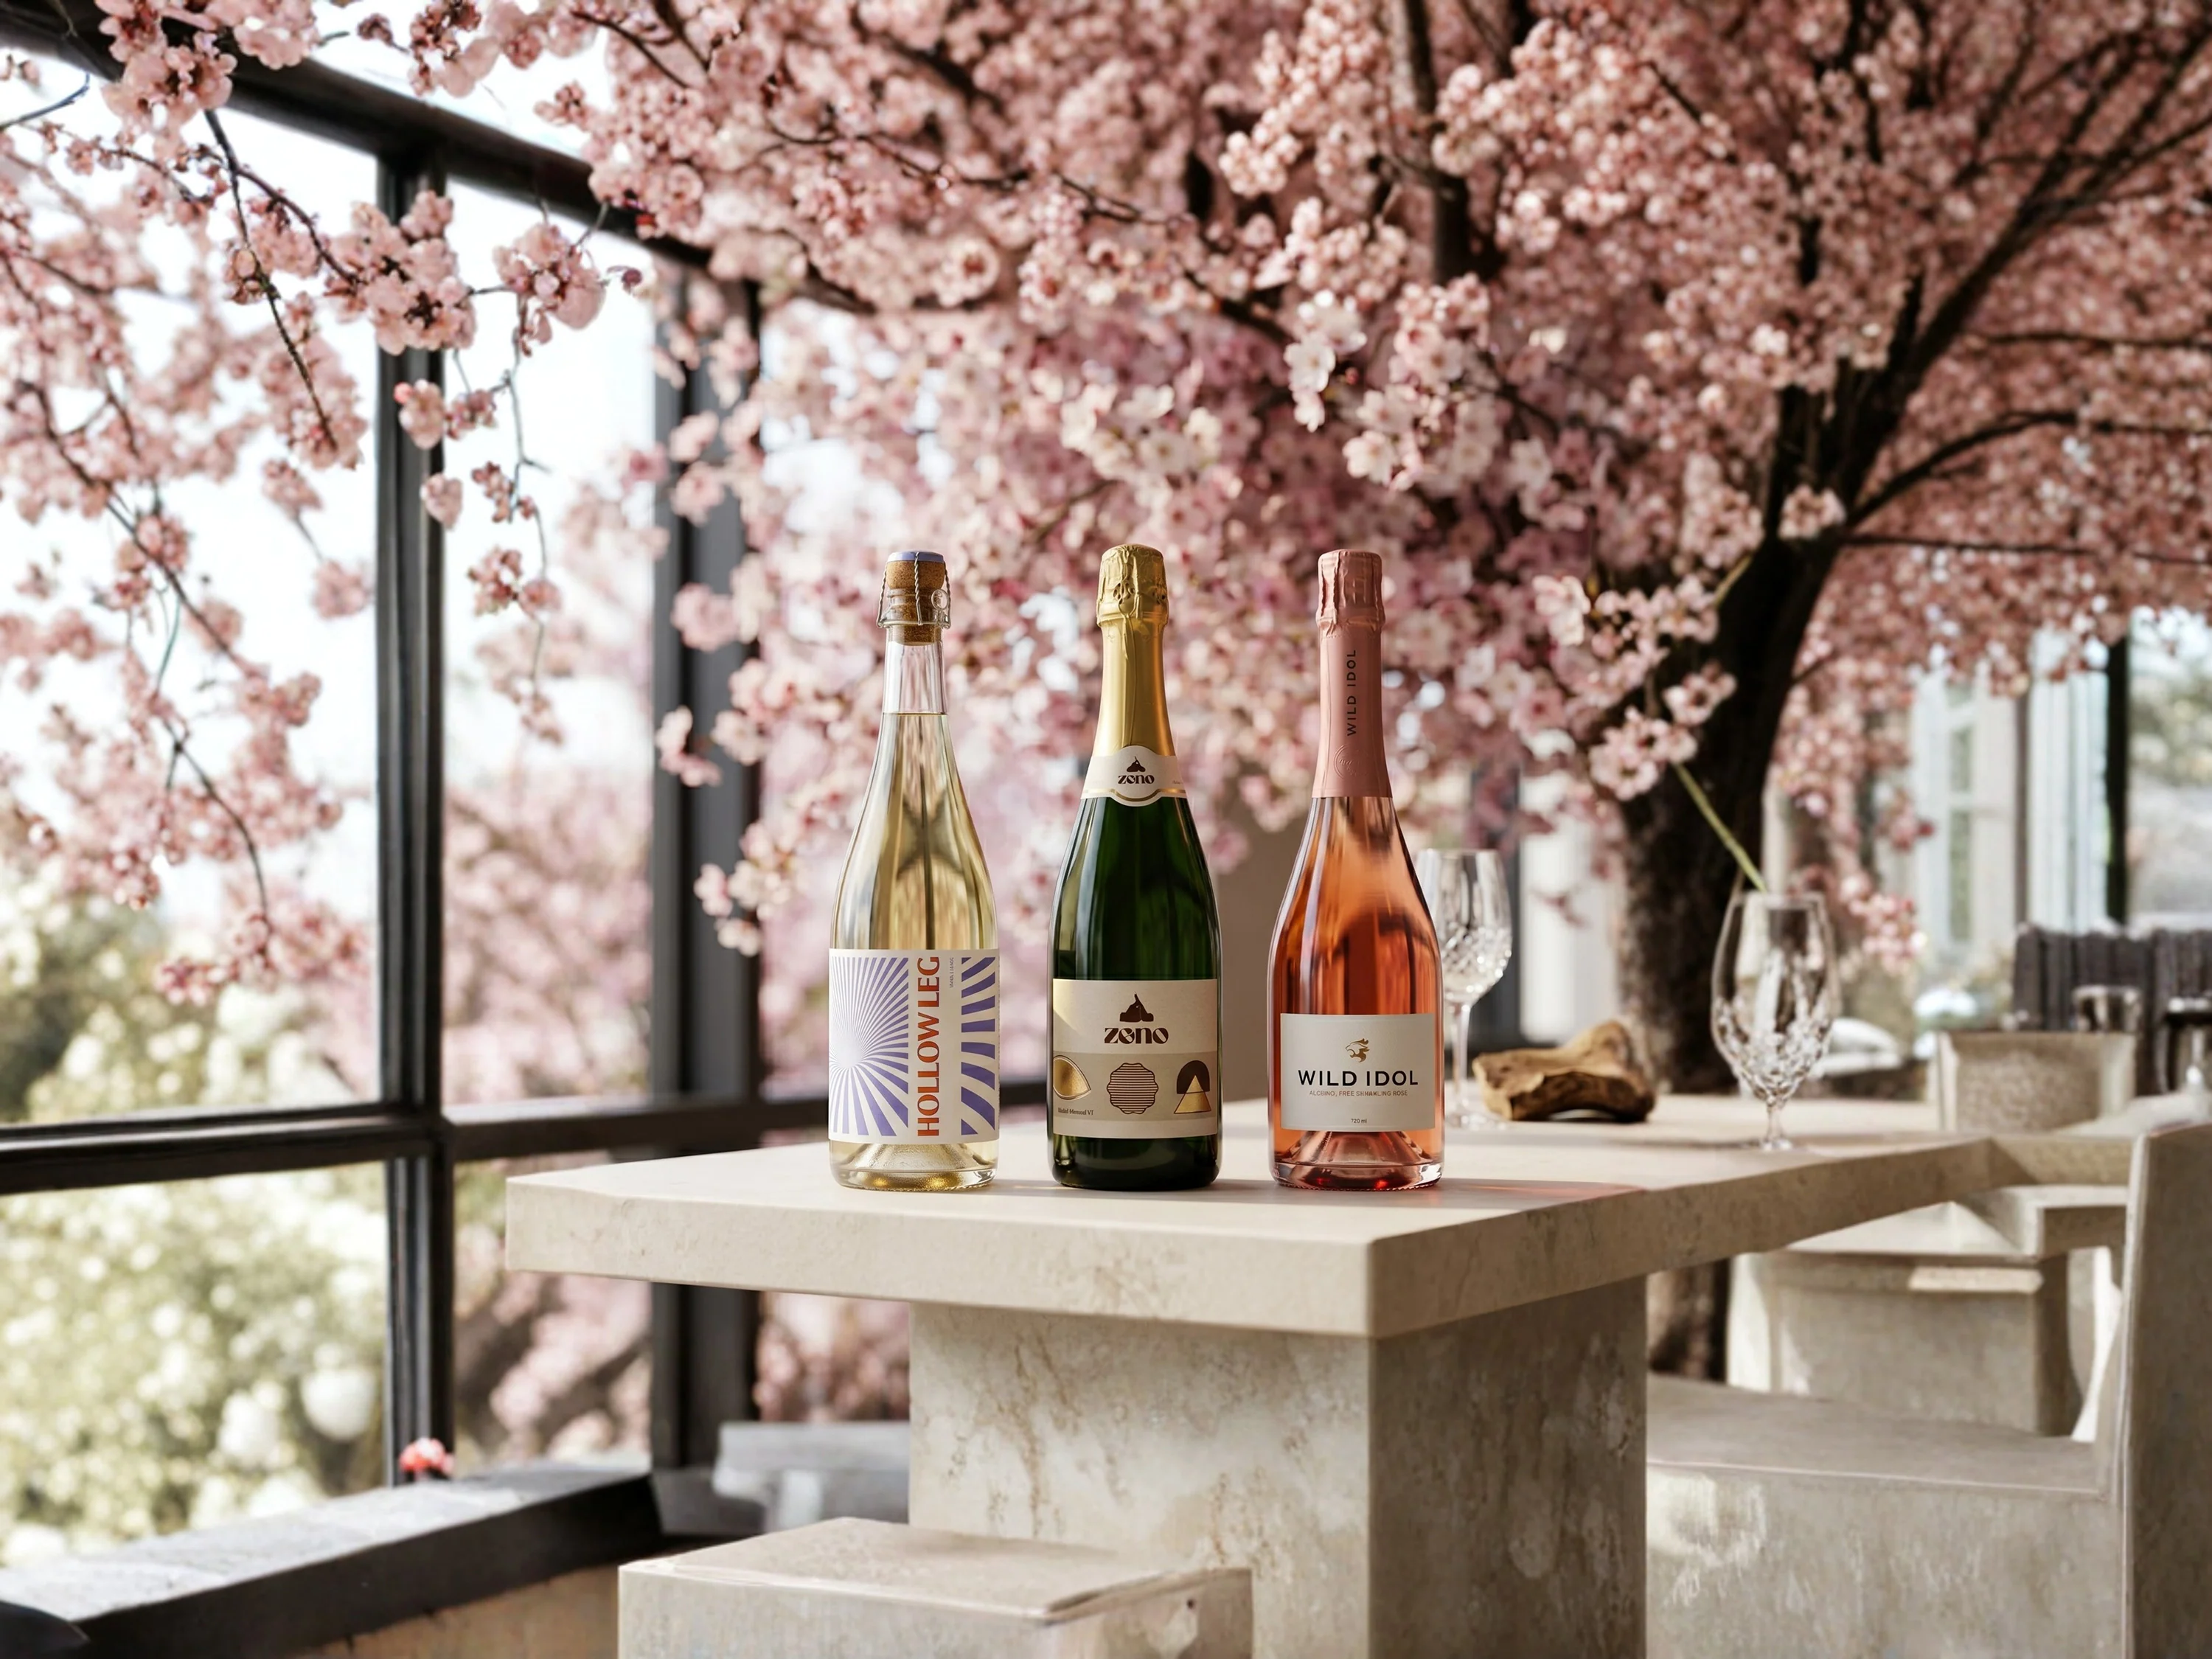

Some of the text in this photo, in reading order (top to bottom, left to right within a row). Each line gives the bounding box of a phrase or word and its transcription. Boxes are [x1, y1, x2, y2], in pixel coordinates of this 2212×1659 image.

[1346, 650, 1357, 737] WILD IDOL
[917, 956, 940, 1136] HOLLOW LEG
[1298, 1070, 1418, 1087] WILD IDOL
